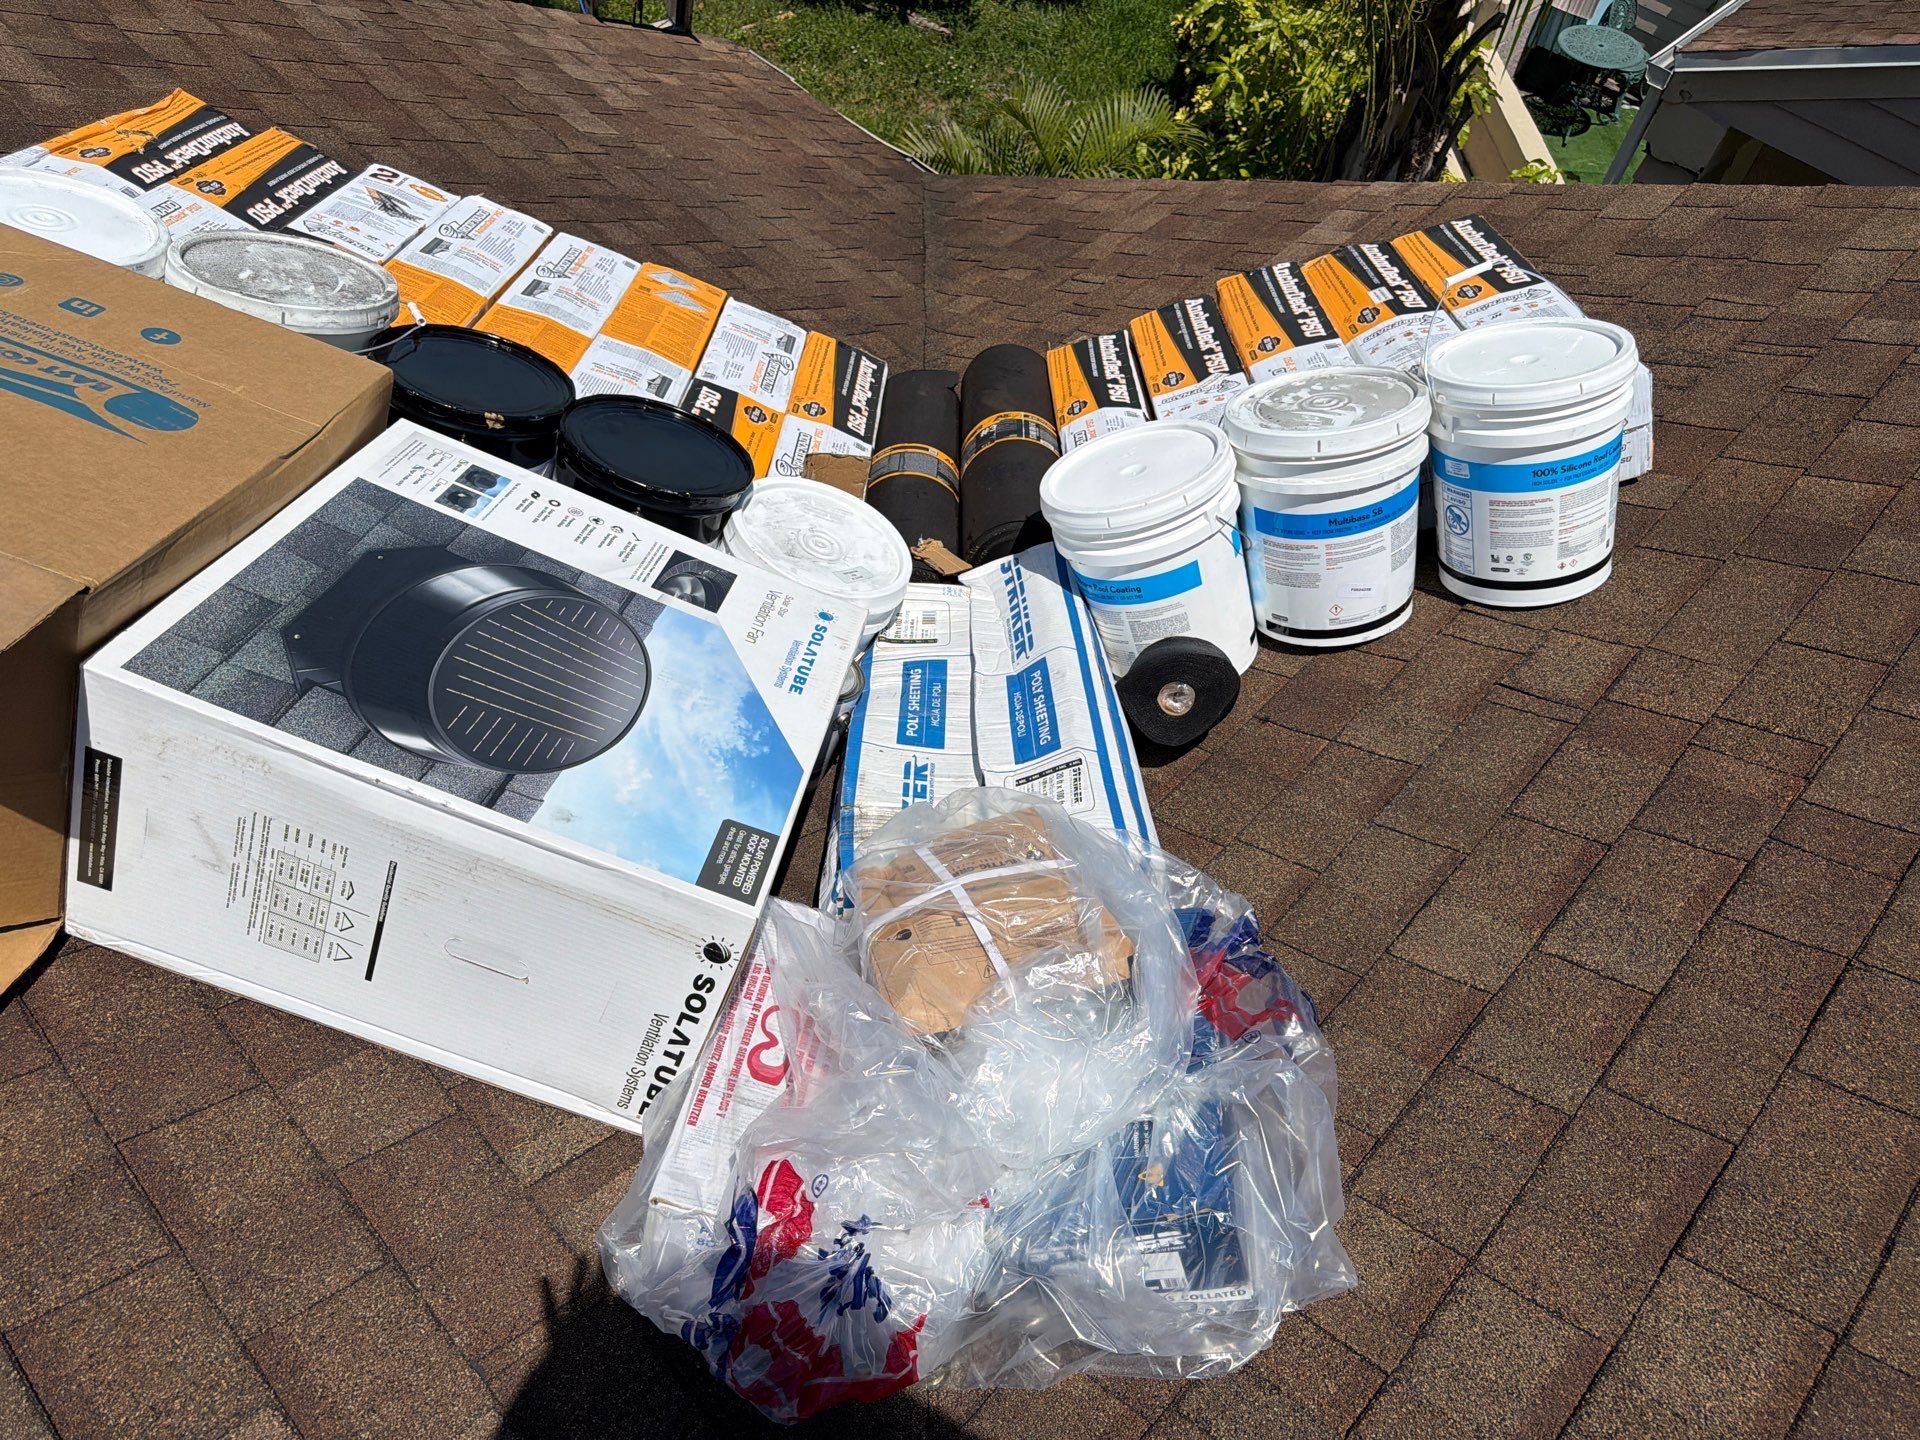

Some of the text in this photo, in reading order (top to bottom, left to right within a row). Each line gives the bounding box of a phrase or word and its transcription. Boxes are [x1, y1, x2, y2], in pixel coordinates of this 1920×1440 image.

[37, 364, 113, 392] EAST
[1532, 452, 1608, 479] 100% Silicone Roof
[1328, 506, 1384, 528] Multibase SB
[1110, 585, 1142, 594] Coating
[744, 587, 782, 646] Ventilation Fan
[1000, 558, 1034, 660] STRIKER
[772, 638, 803, 690] Ventilation Systems
[788, 622, 827, 695] SOLATUBE
[905, 667, 922, 738] POLY SHEETING
[931, 682, 942, 728] HOJA DE POLI
[1030, 669, 1052, 746] POLY SHEETING
[731, 833, 759, 887] ROOF MOUNTED
[740, 836, 770, 895] SOLAR POWERED
[751, 1002, 762, 1011] DE
[709, 1034, 729, 1060] SCHUTZ
[737, 1012, 761, 1046] PROTEGER
[616, 1012, 670, 1110] Ventilation Systems
[699, 1060, 720, 1088] IMMER
[726, 1046, 749, 1078] SIEMPRE
[724, 1078, 737, 1091] LOS
[684, 1088, 710, 1126] BENUTZEN
